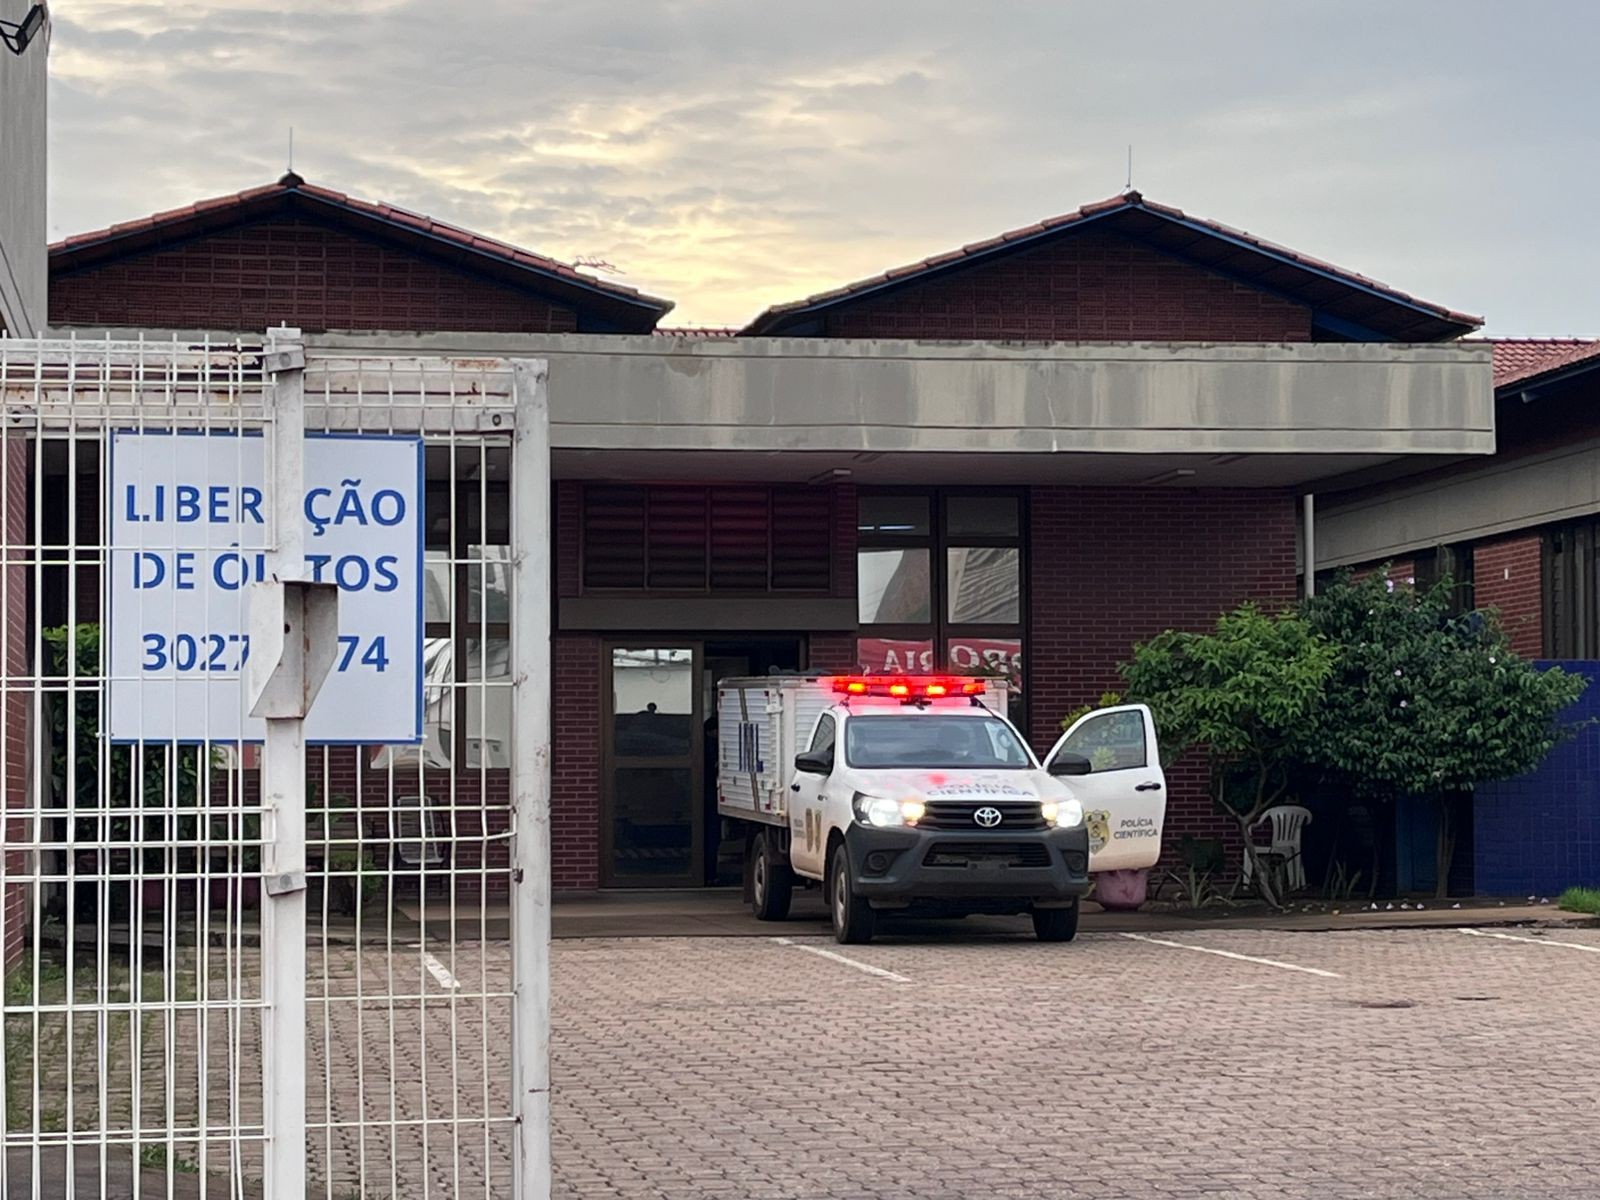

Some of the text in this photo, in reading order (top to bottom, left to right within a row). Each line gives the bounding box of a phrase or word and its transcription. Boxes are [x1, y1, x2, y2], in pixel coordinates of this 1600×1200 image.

[126, 479, 406, 536] LIBERÇÃO
[133, 543, 399, 592] DE ÓTOS
[1121, 818, 1153, 828] POLÍCIA
